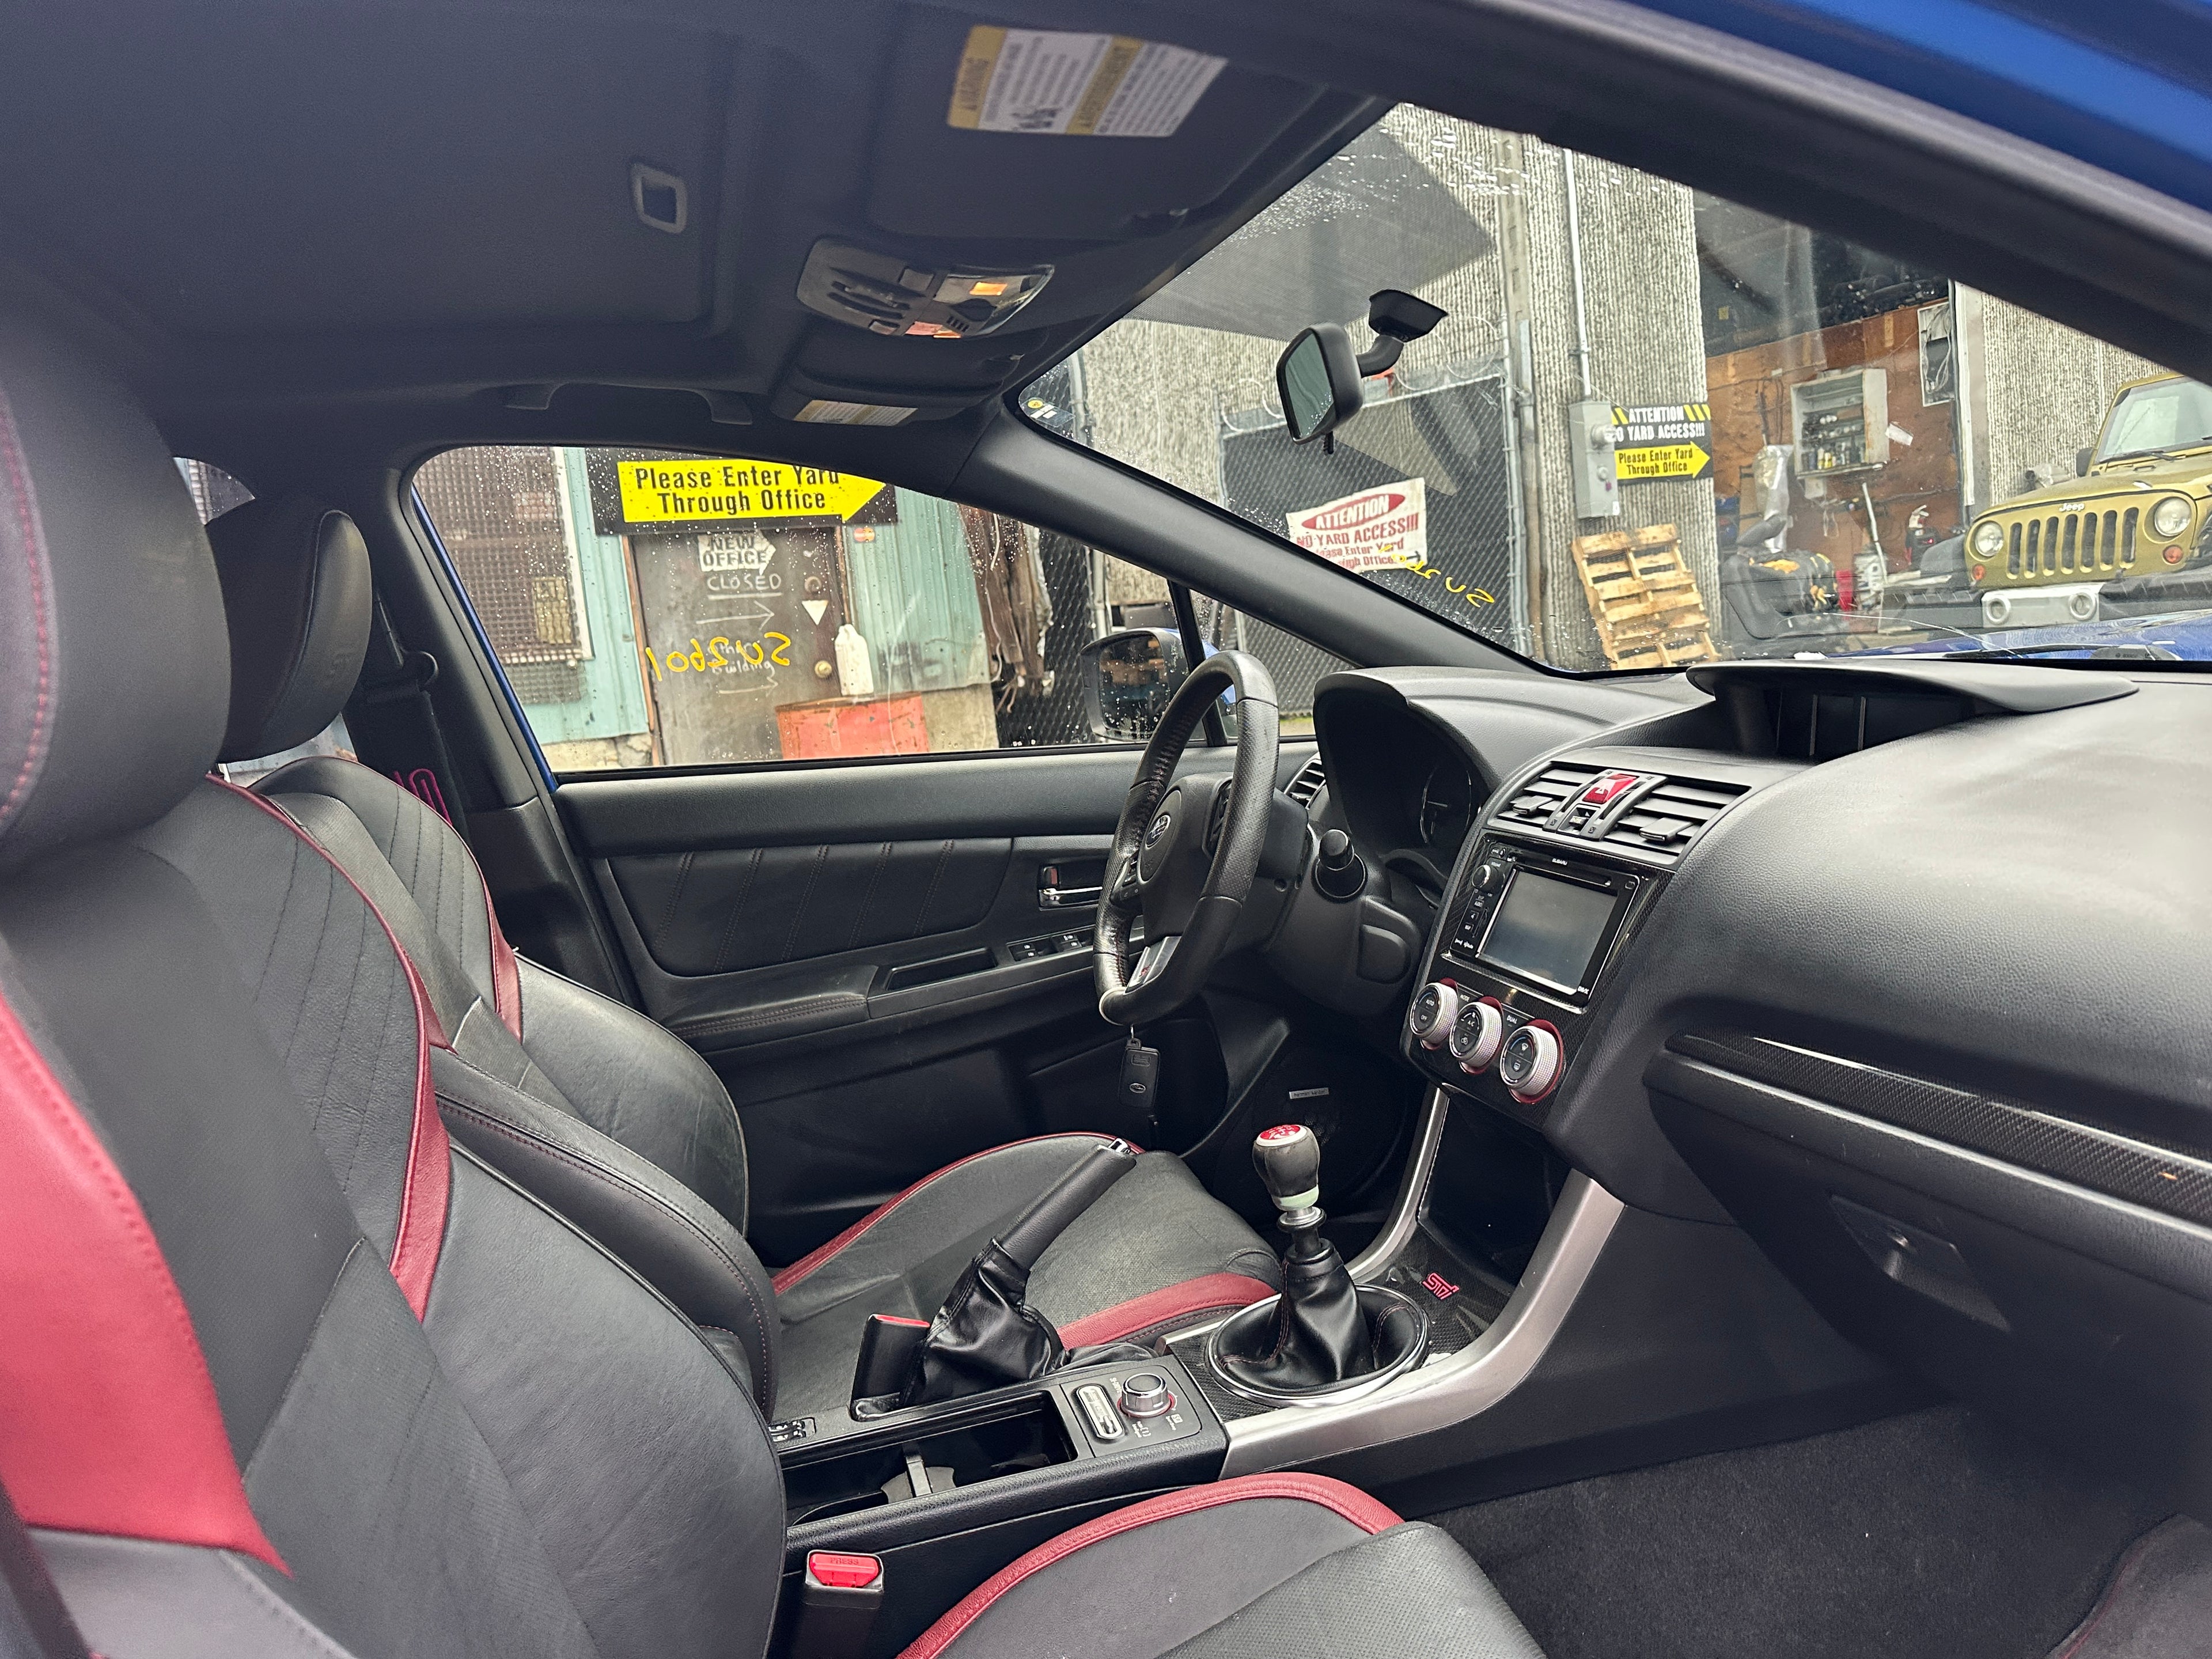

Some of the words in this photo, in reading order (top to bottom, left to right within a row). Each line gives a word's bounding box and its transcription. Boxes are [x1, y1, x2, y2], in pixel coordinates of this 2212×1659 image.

[1628, 406, 1684, 423] ATTENTION
[1627, 425, 1654, 441] YARD
[1658, 422, 1705, 439] ACCESS!!!
[1619, 453, 1646, 464] Please
[1650, 450, 1672, 461] Enter
[1675, 448, 1693, 459] Yard
[1627, 463, 1660, 476] Through
[1663, 461, 1688, 473] Office
[636, 467, 712, 490] Please
[723, 465, 782, 487] Enter
[657, 491, 751, 516] Through
[762, 489, 826, 510] Office
[2058, 502, 2085, 512] Jeep
[1316, 495, 1389, 529] ATTENTION
[711, 536, 755, 550] NEW
[1316, 532, 1350, 546] YARD
[703, 550, 767, 567] OFFICE
[707, 573, 782, 591] CLOSED
[1460, 994, 1471, 1002] MODE
[1506, 1014, 1518, 1024] DUAL
[830, 1557, 859, 1565] PRESS
